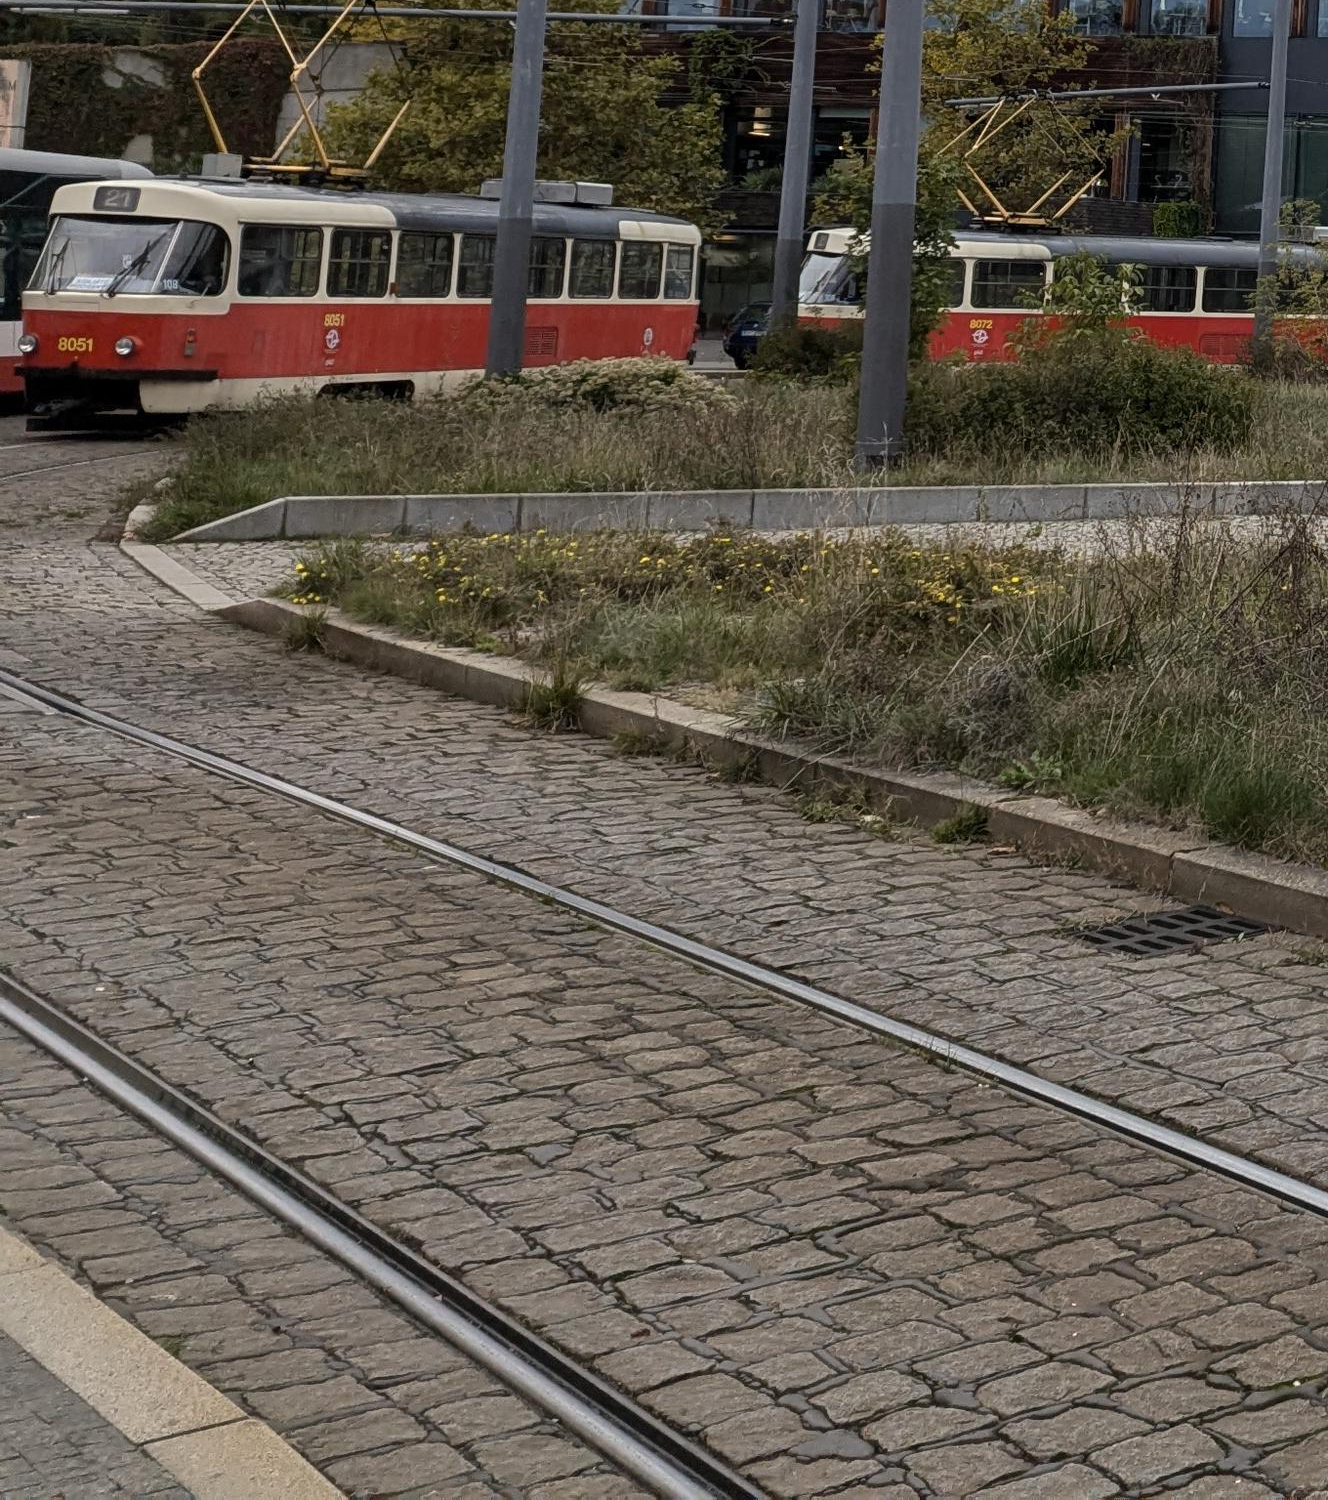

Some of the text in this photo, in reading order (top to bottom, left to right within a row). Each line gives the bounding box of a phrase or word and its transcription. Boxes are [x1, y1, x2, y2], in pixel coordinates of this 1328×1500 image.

[104, 189, 130, 207] 21
[324, 313, 345, 327] 8051
[969, 319, 993, 329] 8072
[58, 336, 94, 352] 8051
